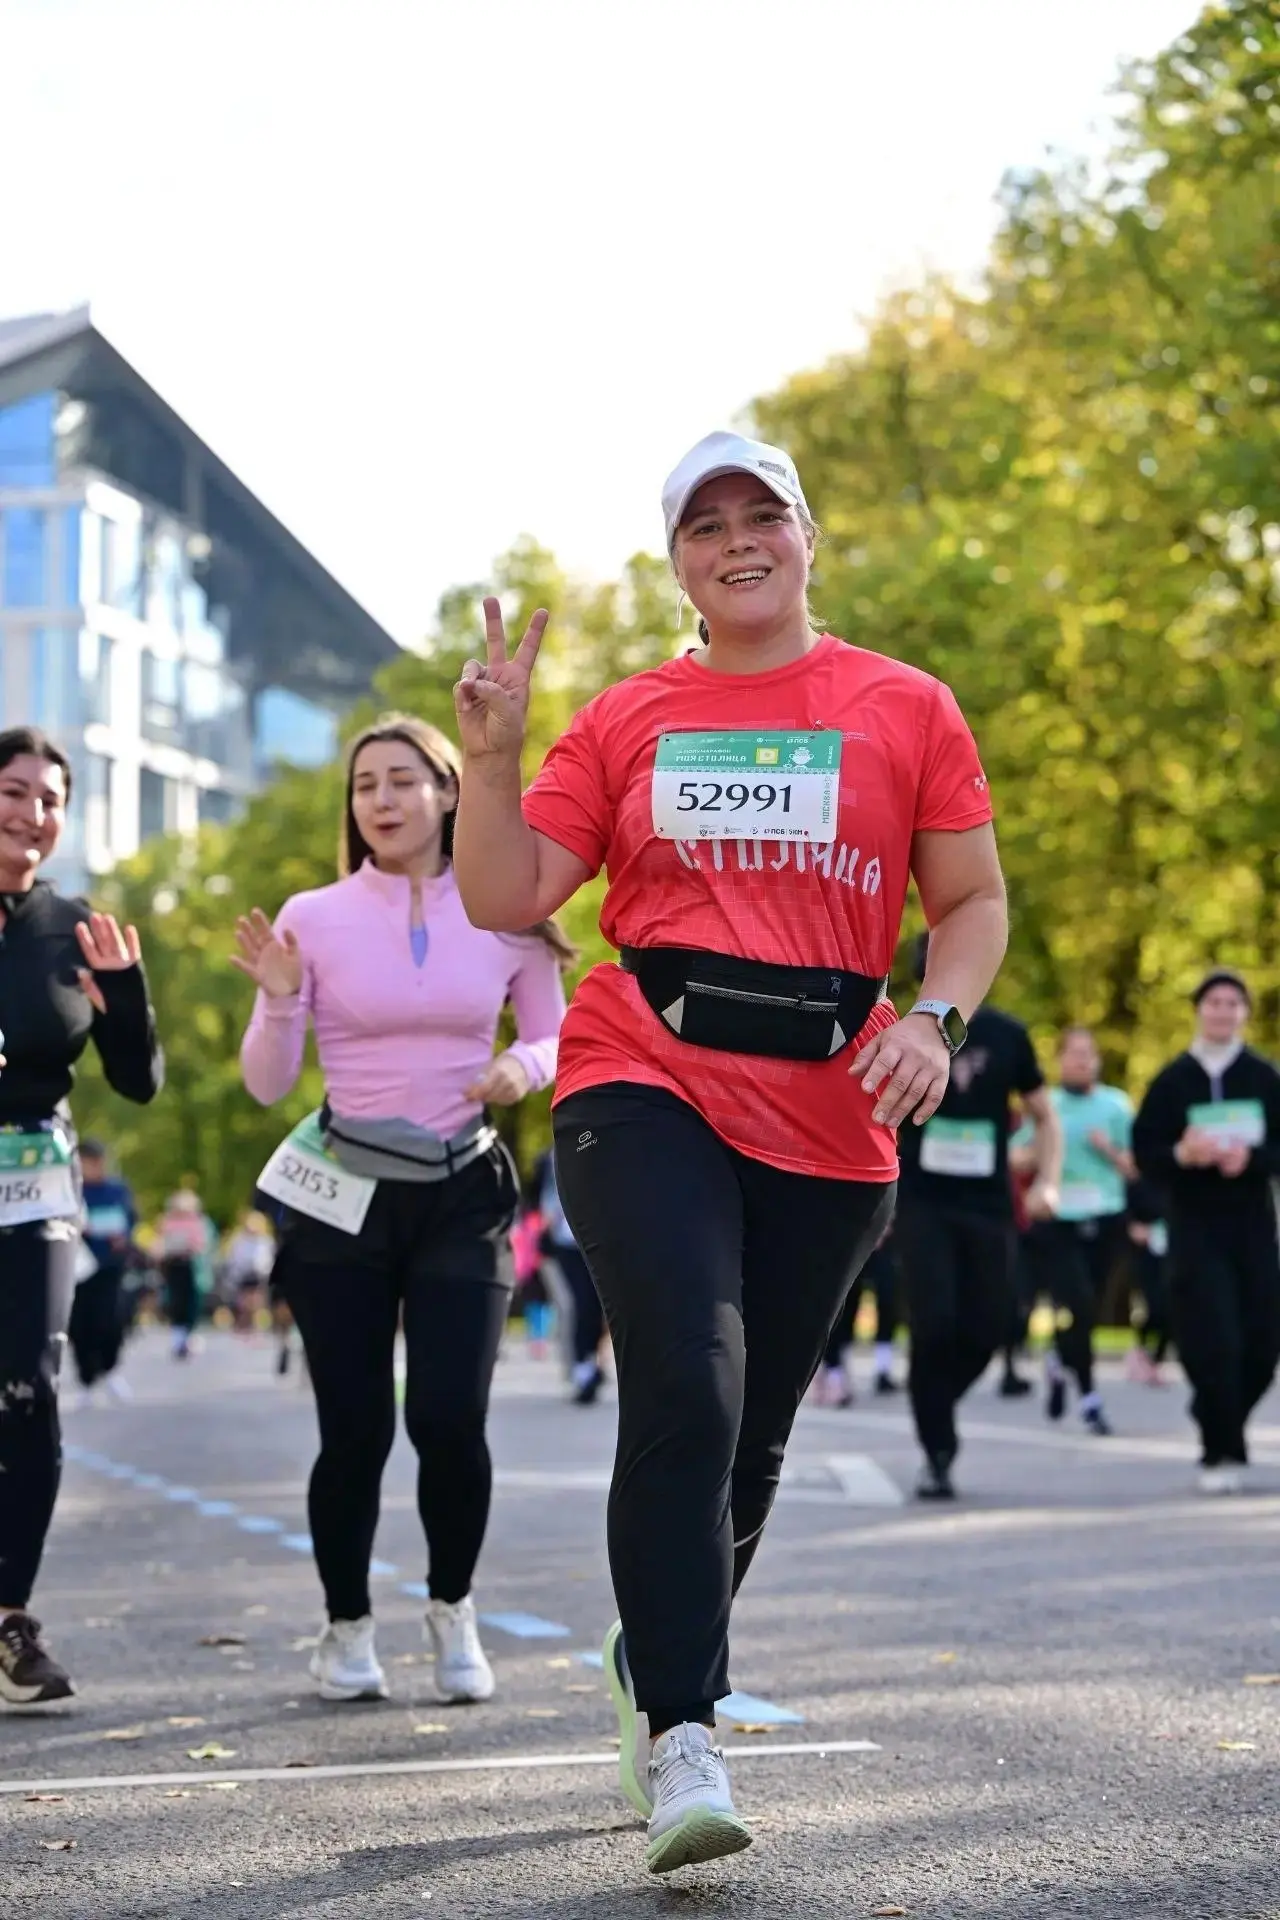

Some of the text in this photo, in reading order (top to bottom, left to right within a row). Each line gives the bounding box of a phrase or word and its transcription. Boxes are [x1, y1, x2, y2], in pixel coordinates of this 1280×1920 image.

[676, 782, 792, 813] 52991
[0, 1180, 41, 1203] 156
[277, 1155, 340, 1200] 52153
